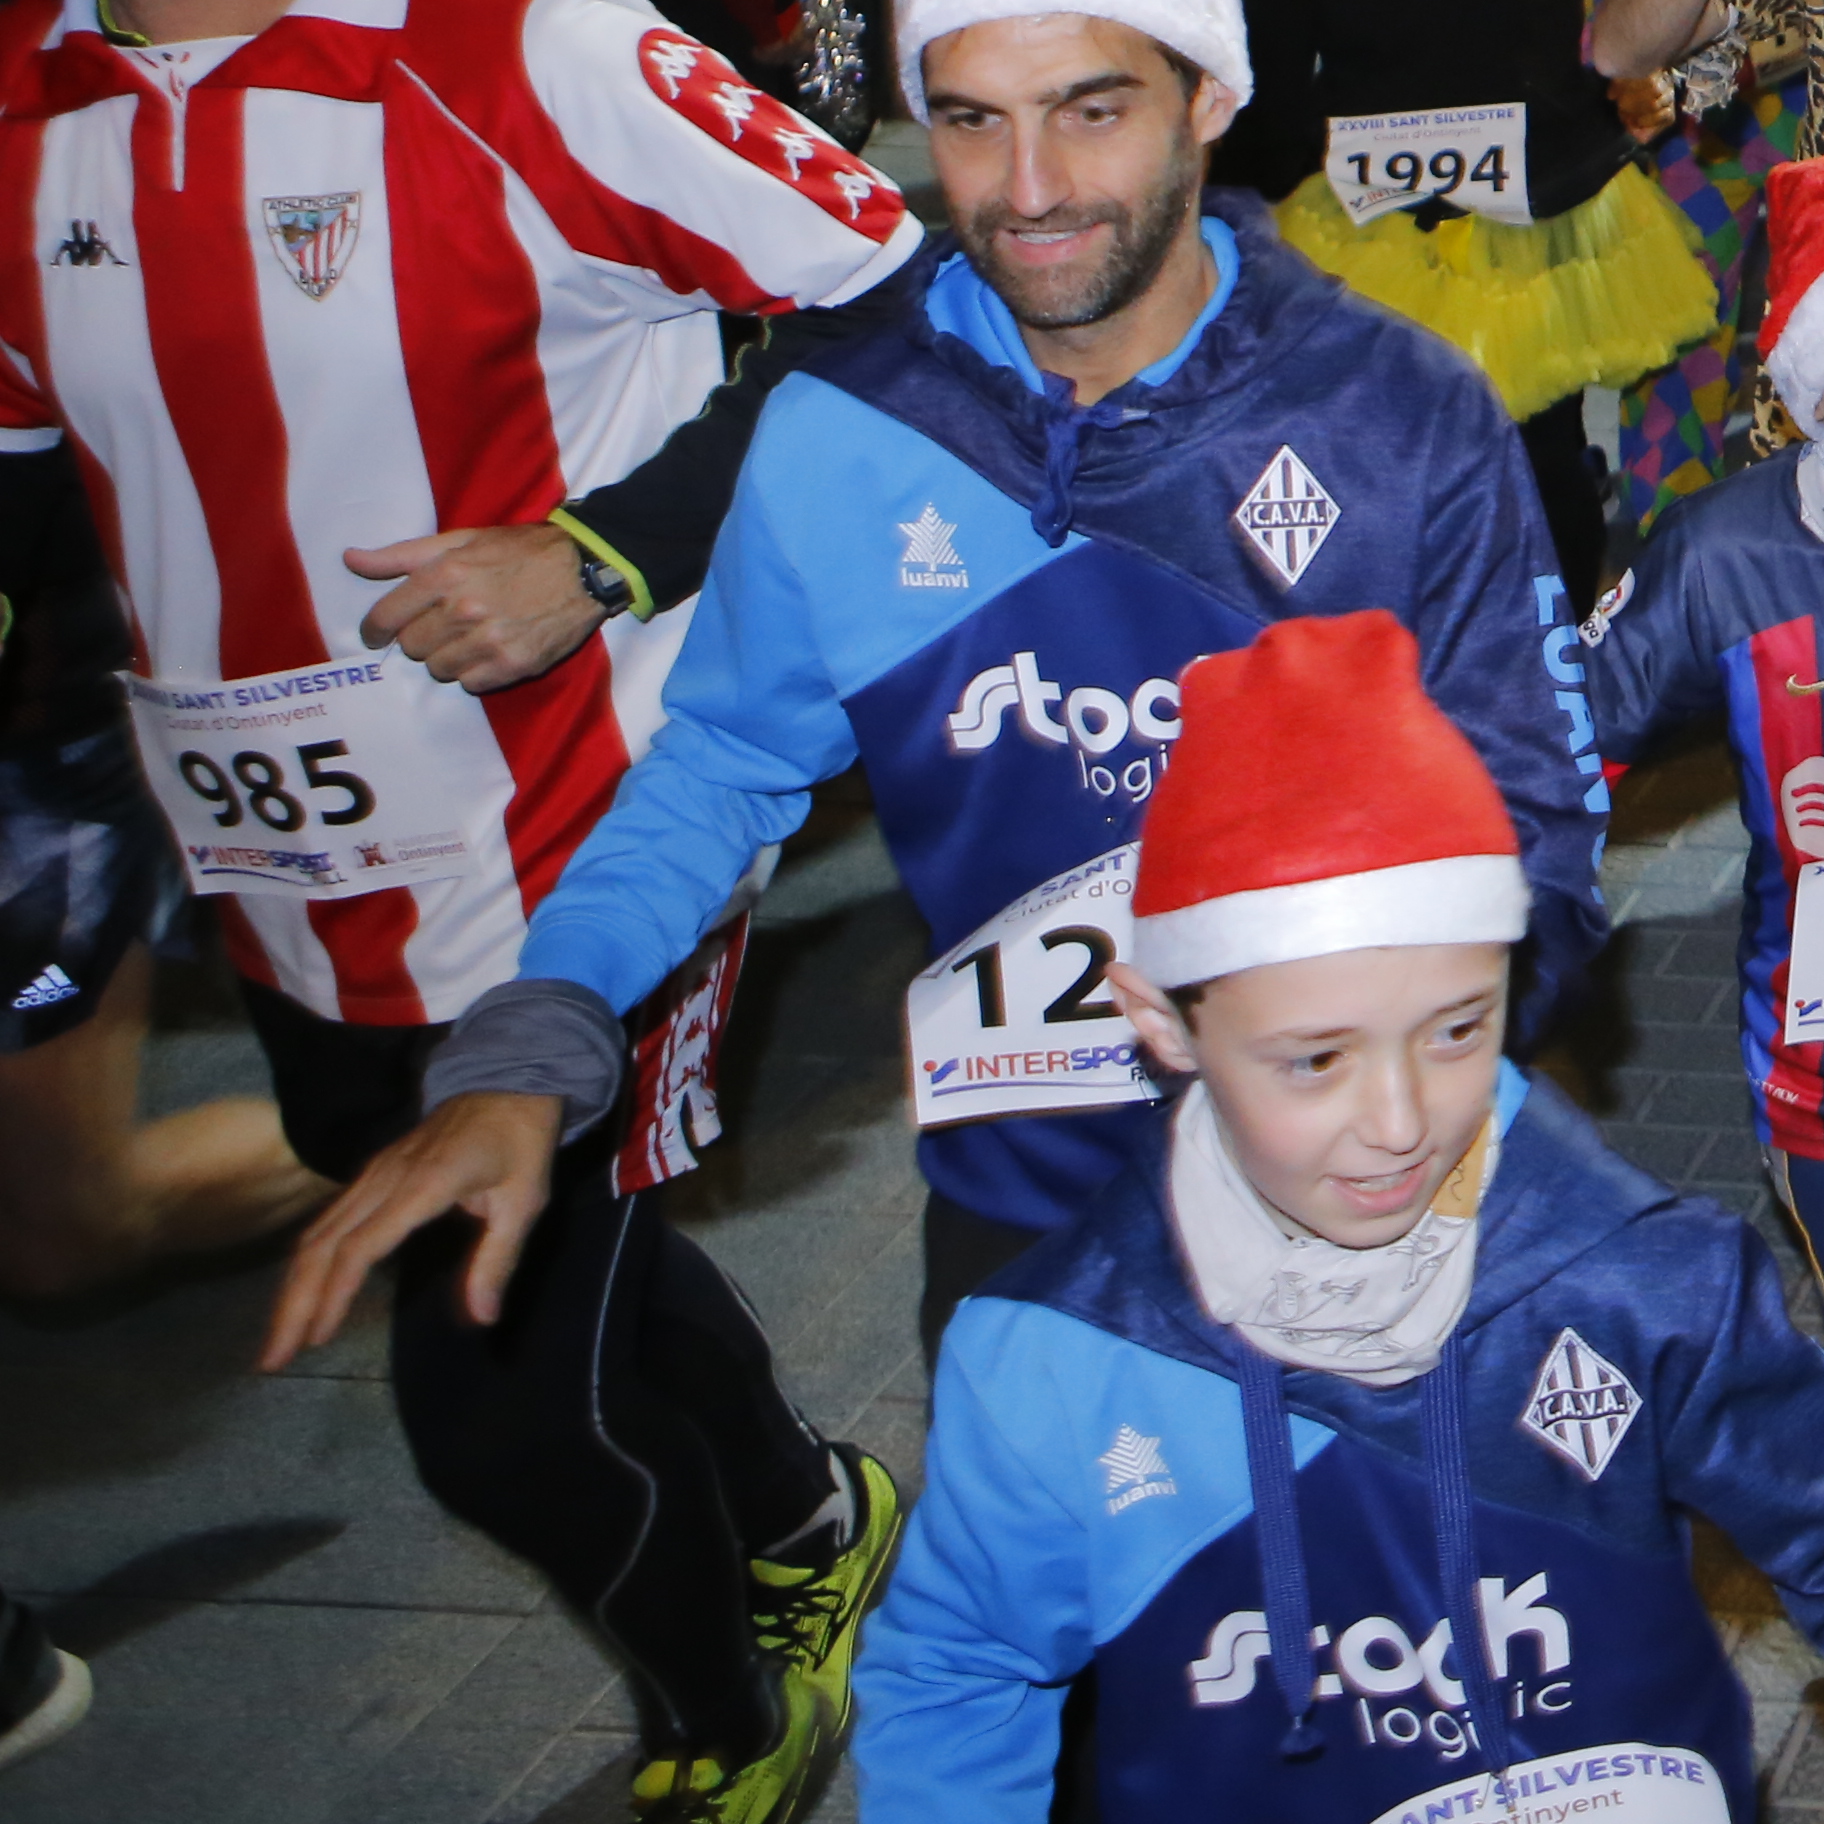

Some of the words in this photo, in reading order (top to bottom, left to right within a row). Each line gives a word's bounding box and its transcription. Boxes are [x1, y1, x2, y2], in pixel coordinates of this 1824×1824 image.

[1338, 118, 1386, 131] XXVIII
[1389, 115, 1429, 128] SANT
[1435, 107, 1516, 124] SILVESTRE
[1346, 142, 1511, 196] 1994
[1253, 501, 1326, 528] C.A.V.A.
[901, 566, 969, 590] luanvi
[173, 690, 227, 711] SANT
[236, 662, 385, 707] SILVESTRE
[178, 738, 378, 833] 985
[1080, 743, 1169, 804] logi
[1040, 851, 1128, 897] SANT
[12, 986, 80, 1009] adidas
[965, 1042, 1136, 1081] INTERSPO
[1543, 1387, 1626, 1421] C.A.V.A.
[1107, 1477, 1178, 1516] luanvi
[1357, 1680, 1574, 1760] logiic
[1400, 1788, 1480, 1824] ANT
[1494, 1752, 1706, 1806] SILVESTRE
